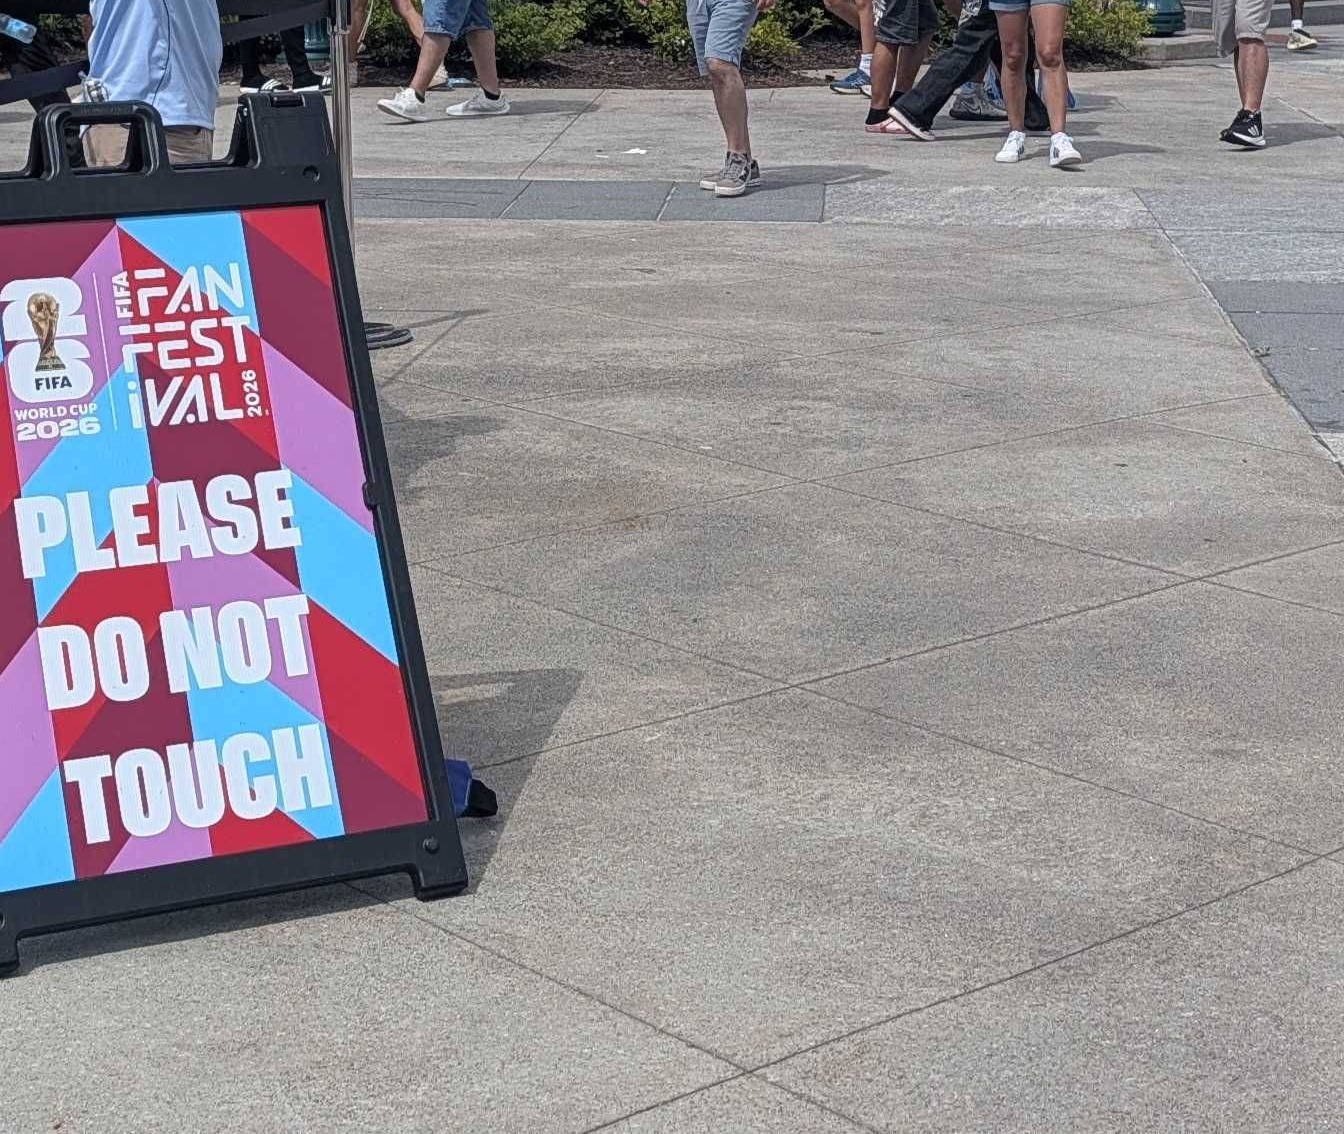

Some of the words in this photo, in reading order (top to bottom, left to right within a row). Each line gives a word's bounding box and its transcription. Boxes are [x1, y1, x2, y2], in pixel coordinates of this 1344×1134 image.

[112, 270, 134, 318] FIFA
[134, 262, 244, 316] FAN
[119, 315, 250, 373] FEST
[34, 375, 72, 391] FIFA
[241, 369, 262, 417] 2026
[14, 405, 68, 421] WORLD
[69, 402, 97, 416] CUP
[16, 416, 101, 441] 2026
[14, 469, 303, 579] PLEASE
[38, 616, 150, 710] DO
[159, 594, 310, 694] NOT
[63, 723, 333, 844] TOUCH
